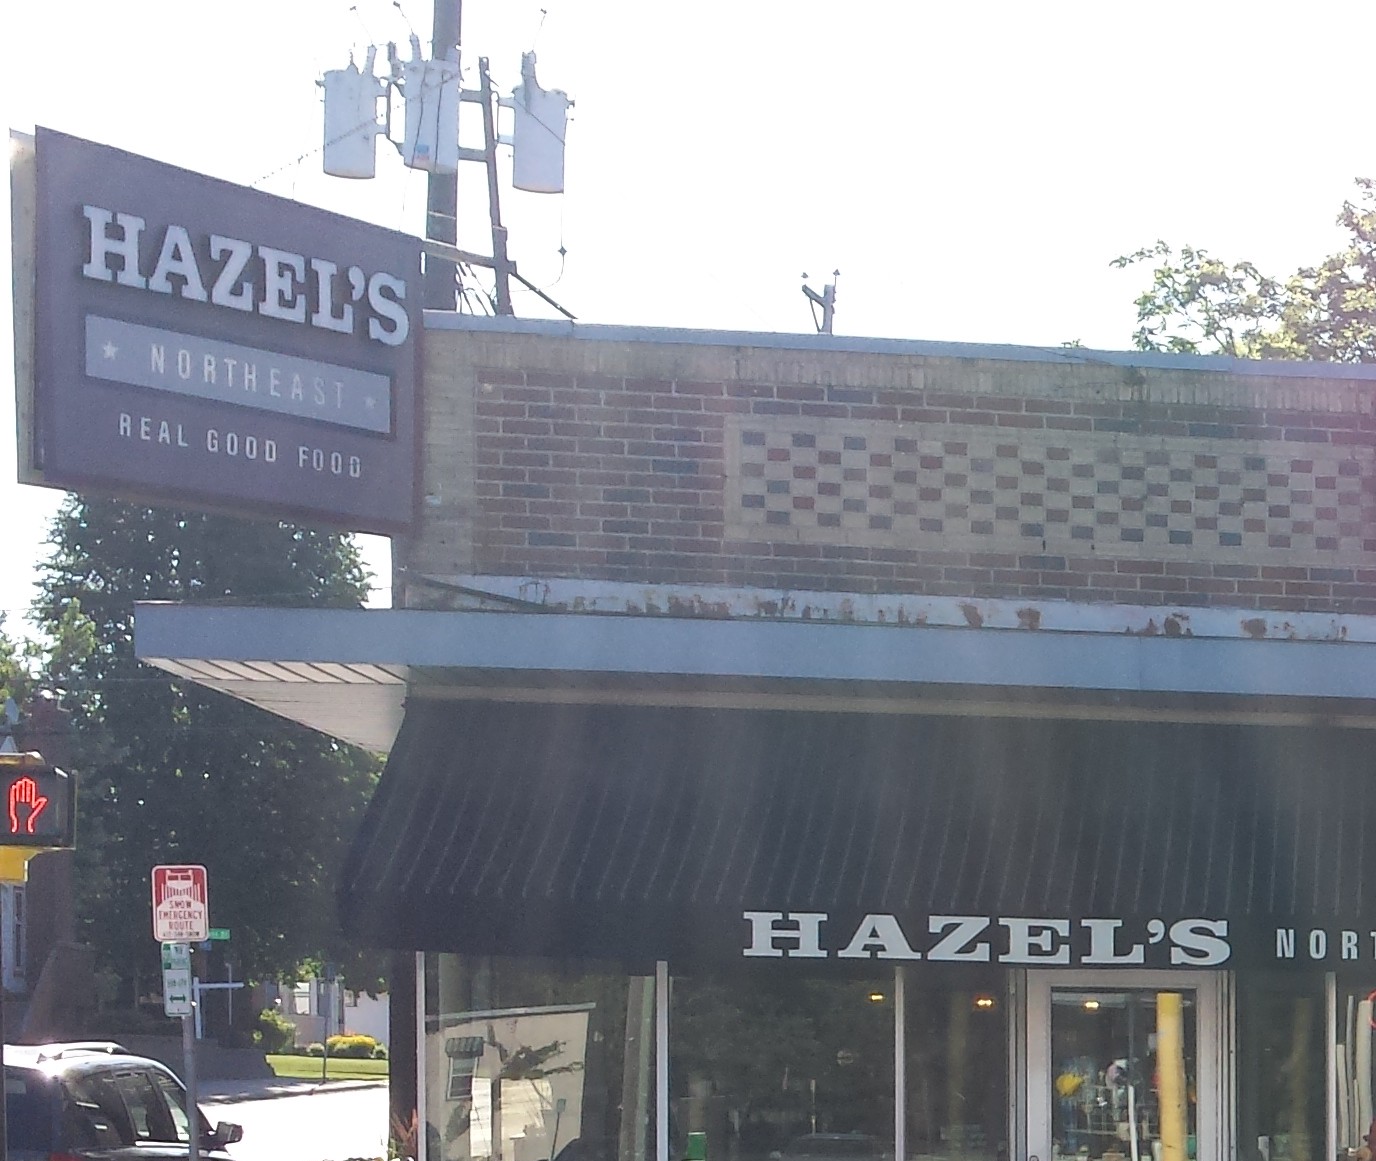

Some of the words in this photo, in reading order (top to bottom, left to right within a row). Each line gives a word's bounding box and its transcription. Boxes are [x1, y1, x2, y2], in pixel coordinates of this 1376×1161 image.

[82, 204, 410, 347] HAZEL'S
[150, 342, 346, 410] NORTHEAST
[119, 413, 189, 448] REAL
[206, 429, 278, 464] GOOD
[298, 445, 362, 479] FOOD
[159, 910, 203, 920] EMERGENCY
[168, 920, 193, 930] ROUTE
[169, 900, 192, 909] SNOW
[742, 910, 1232, 967] HAZEL'S
